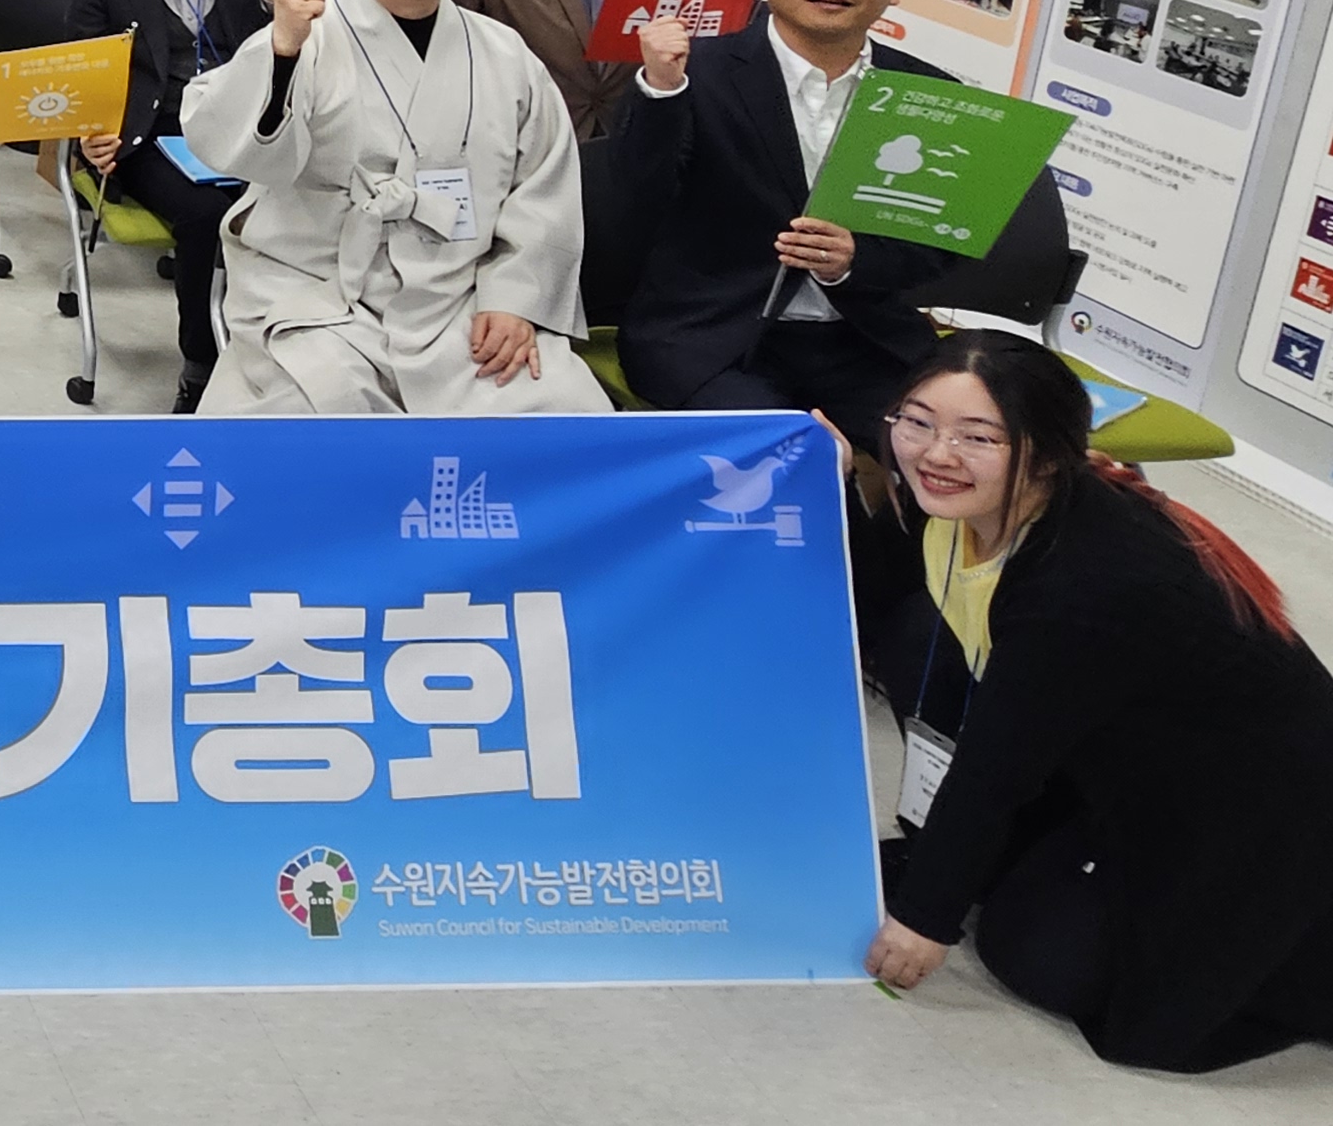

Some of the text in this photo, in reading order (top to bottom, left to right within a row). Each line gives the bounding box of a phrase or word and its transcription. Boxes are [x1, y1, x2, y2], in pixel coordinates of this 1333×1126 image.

[1, 62, 11, 79] 1
[868, 86, 894, 112] 2
[902, 90, 953, 110] 건강하고
[876, 210, 895, 221] UN
[372, 858, 724, 906] 수원지속가능발전협의회
[378, 916, 729, 938] Suwon Council for Sustainable Development
